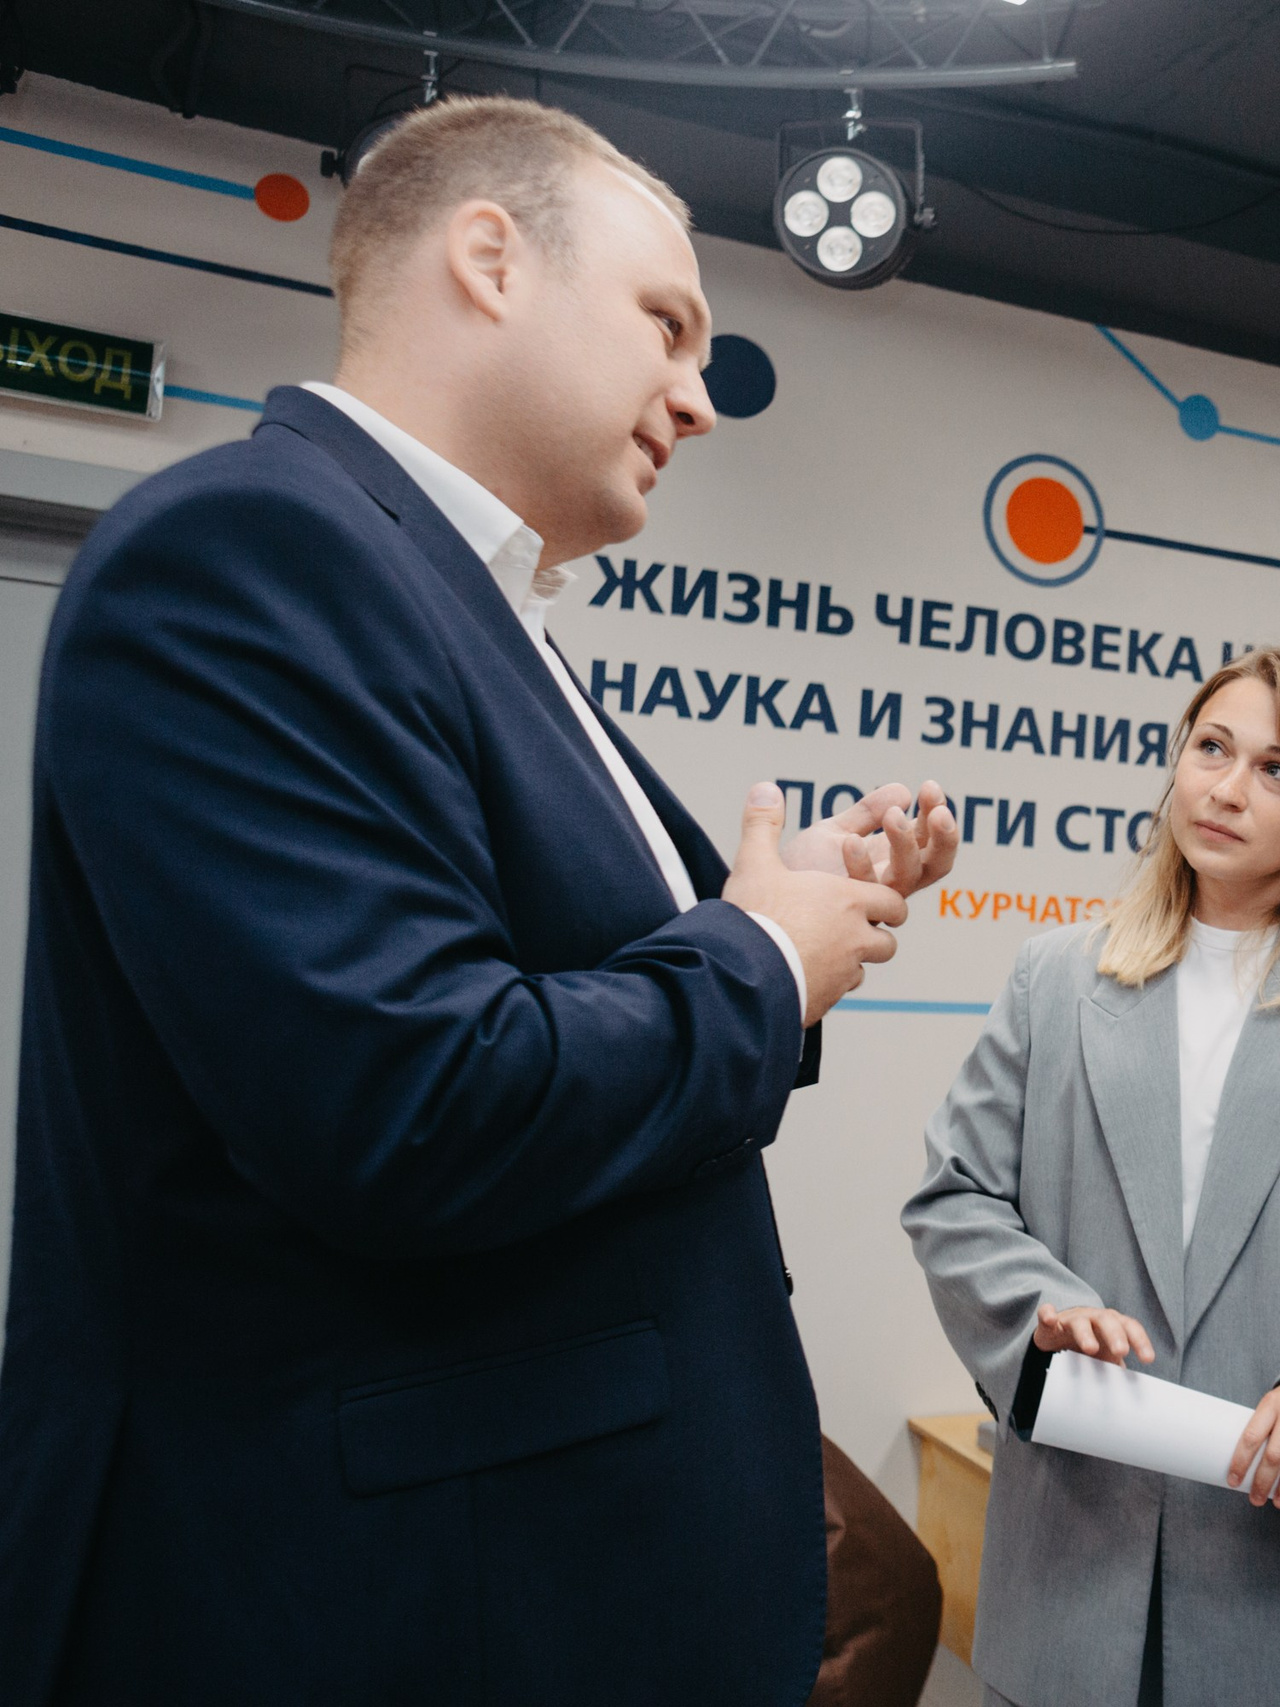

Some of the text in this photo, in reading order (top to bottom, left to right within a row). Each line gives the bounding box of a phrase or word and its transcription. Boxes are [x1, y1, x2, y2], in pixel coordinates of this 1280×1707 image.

[588, 554, 855, 637] ЖИЗНЬ
[874, 594, 1204, 683] ЧЕЛОВЕКА
[589, 659, 840, 736] НАУКА
[857, 688, 902, 741] И
[921, 697, 1168, 768] ЗНАНИЯ
[775, 778, 1160, 858] ПОГИ СТО
[939, 888, 1122, 925] КУРЧАТ
